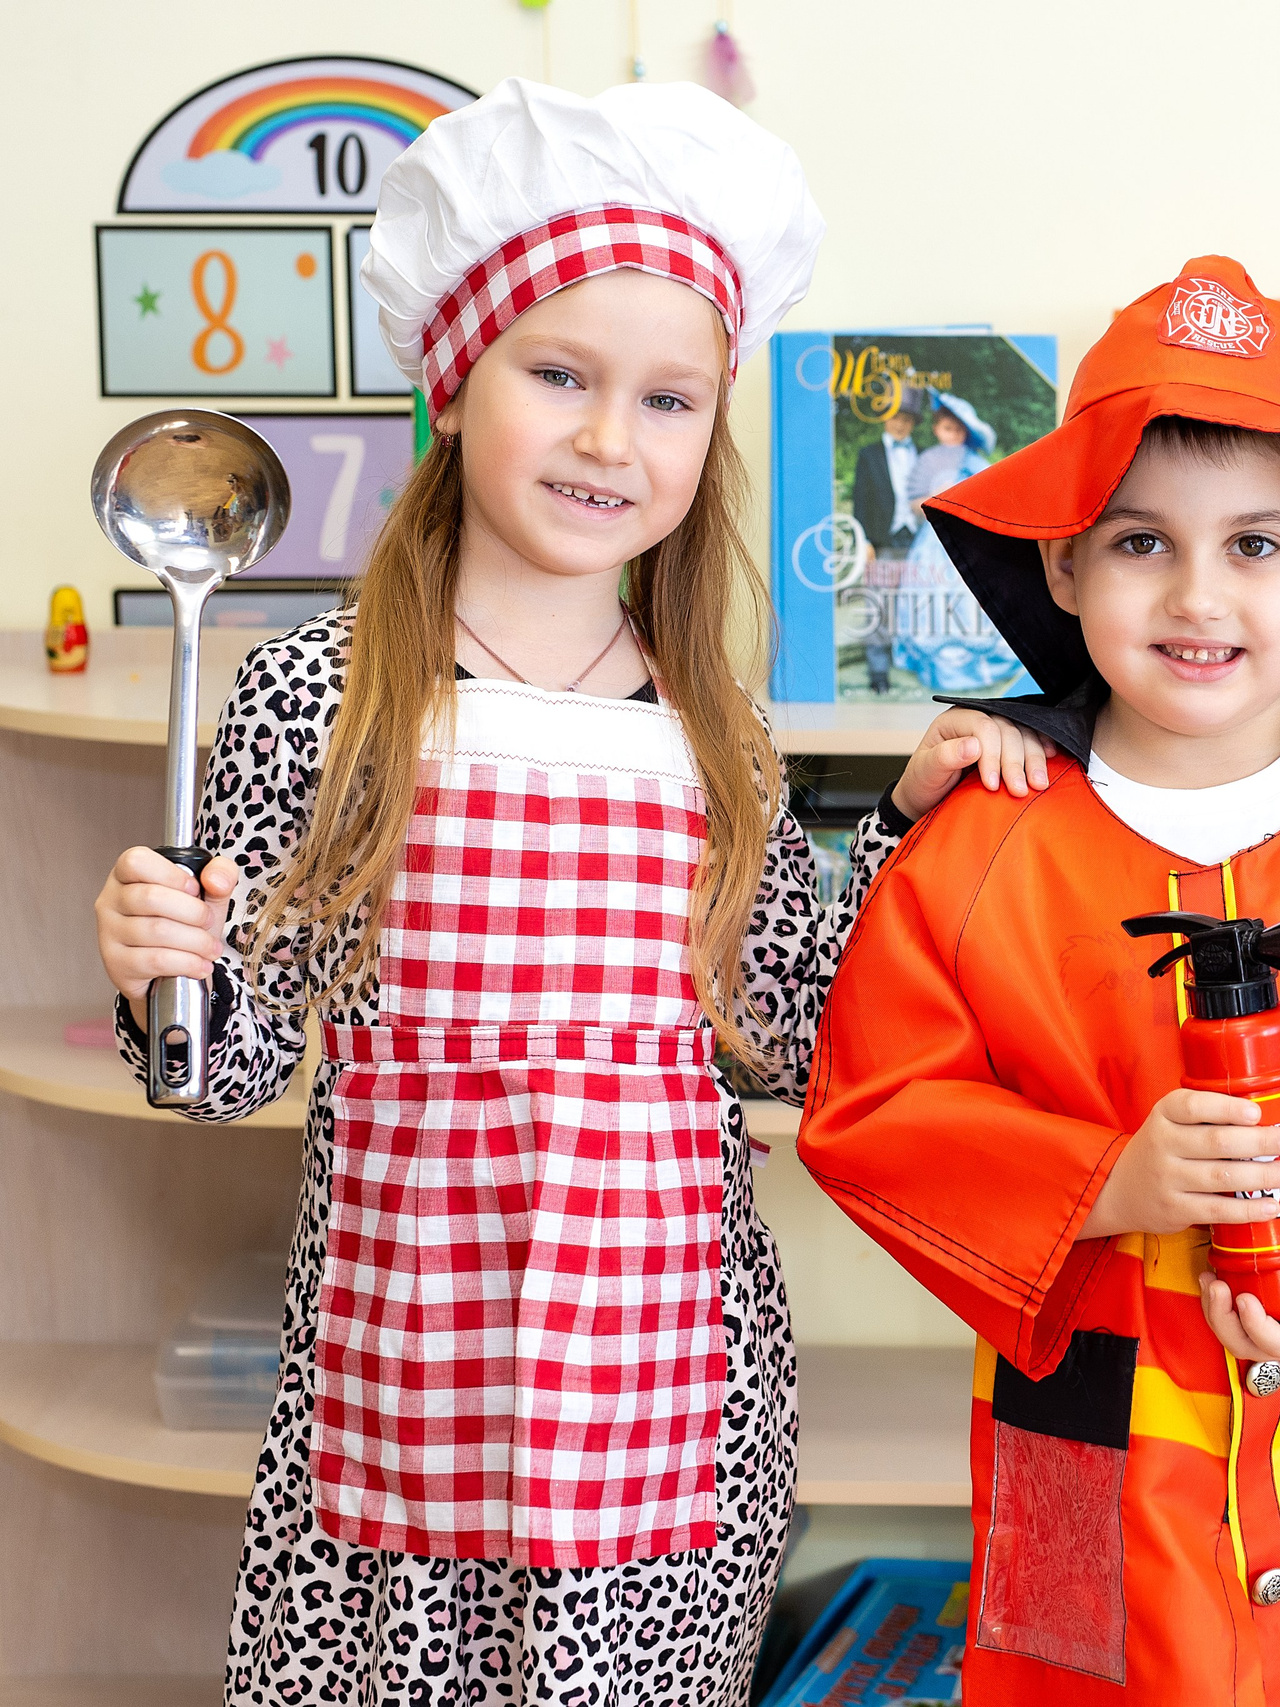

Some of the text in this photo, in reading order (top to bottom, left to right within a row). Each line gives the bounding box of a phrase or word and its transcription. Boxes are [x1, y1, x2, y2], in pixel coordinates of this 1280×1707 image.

[307, 131, 368, 198] 10
[190, 249, 244, 375] 8
[1208, 284, 1235, 303] FIRE
[1191, 332, 1236, 349] RESCUE
[309, 435, 364, 560] 7
